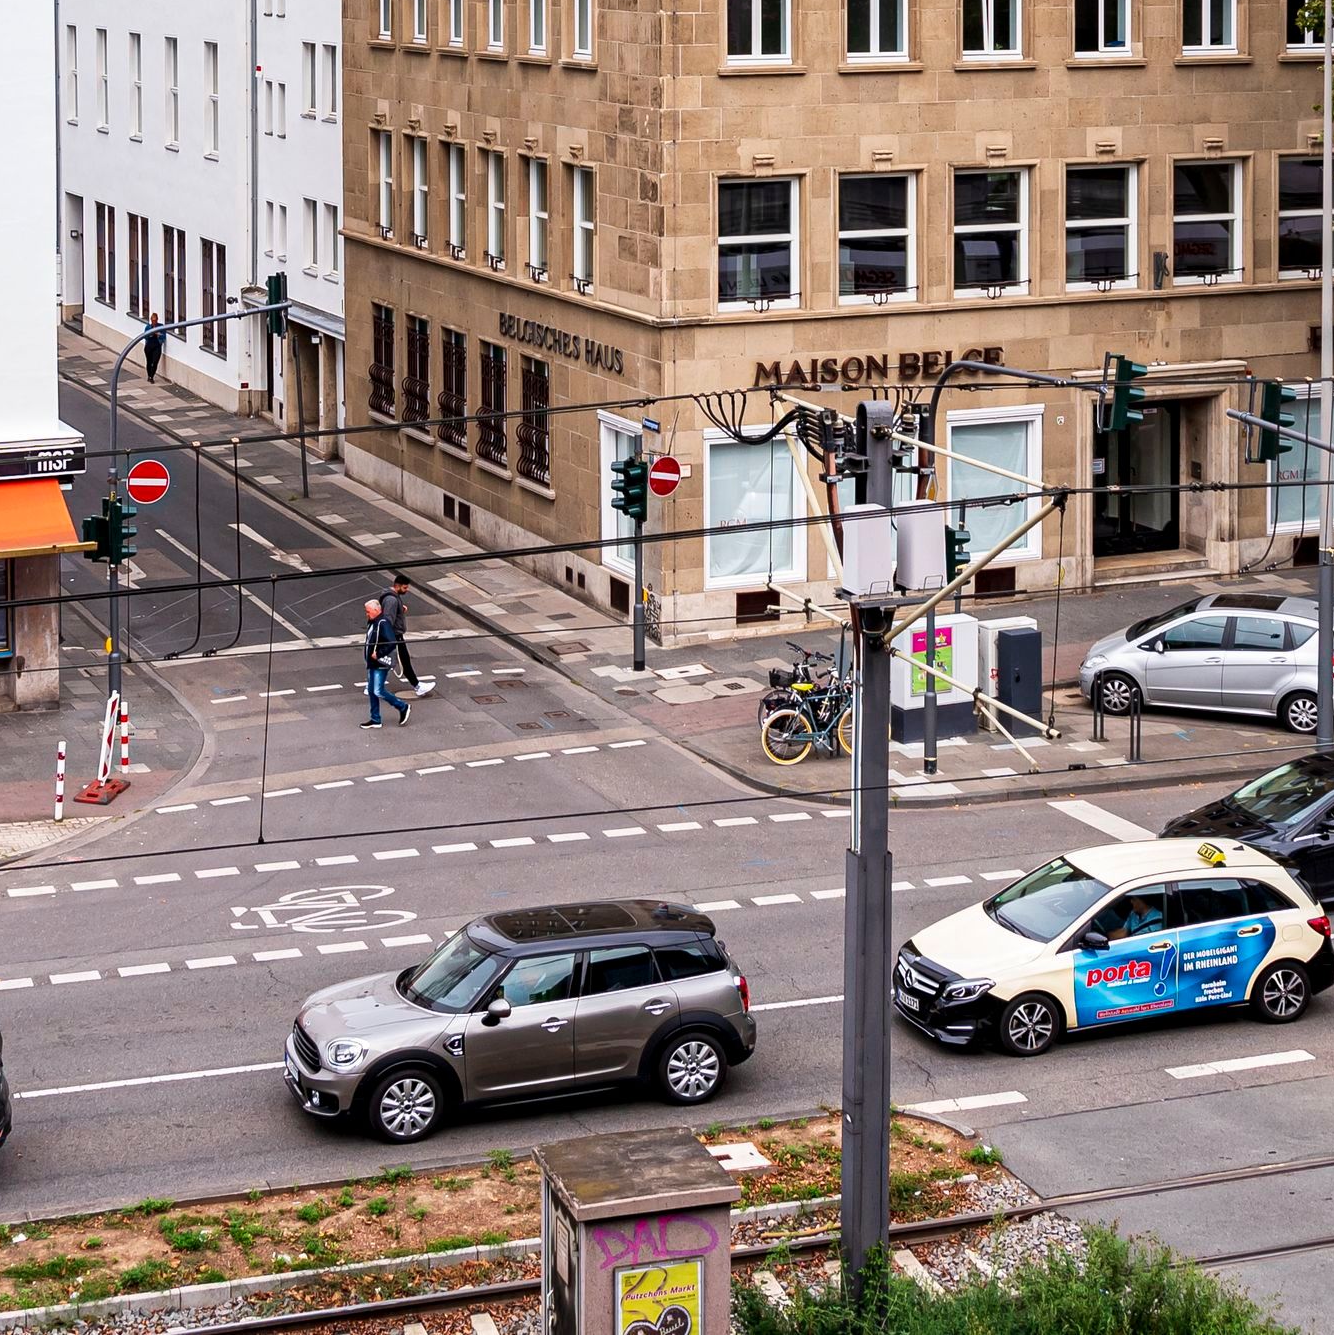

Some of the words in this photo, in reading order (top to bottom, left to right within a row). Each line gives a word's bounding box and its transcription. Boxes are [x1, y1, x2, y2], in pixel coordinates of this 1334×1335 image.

[499, 312, 581, 360] BELGISCHES
[585, 339, 624, 375] HAUS
[754, 353, 889, 387] MAISON
[1086, 959, 1152, 987] porta
[1184, 962, 1194, 972] IM
[1196, 955, 1238, 970] RHEINLAND
[670, 1284, 695, 1294] Markt
